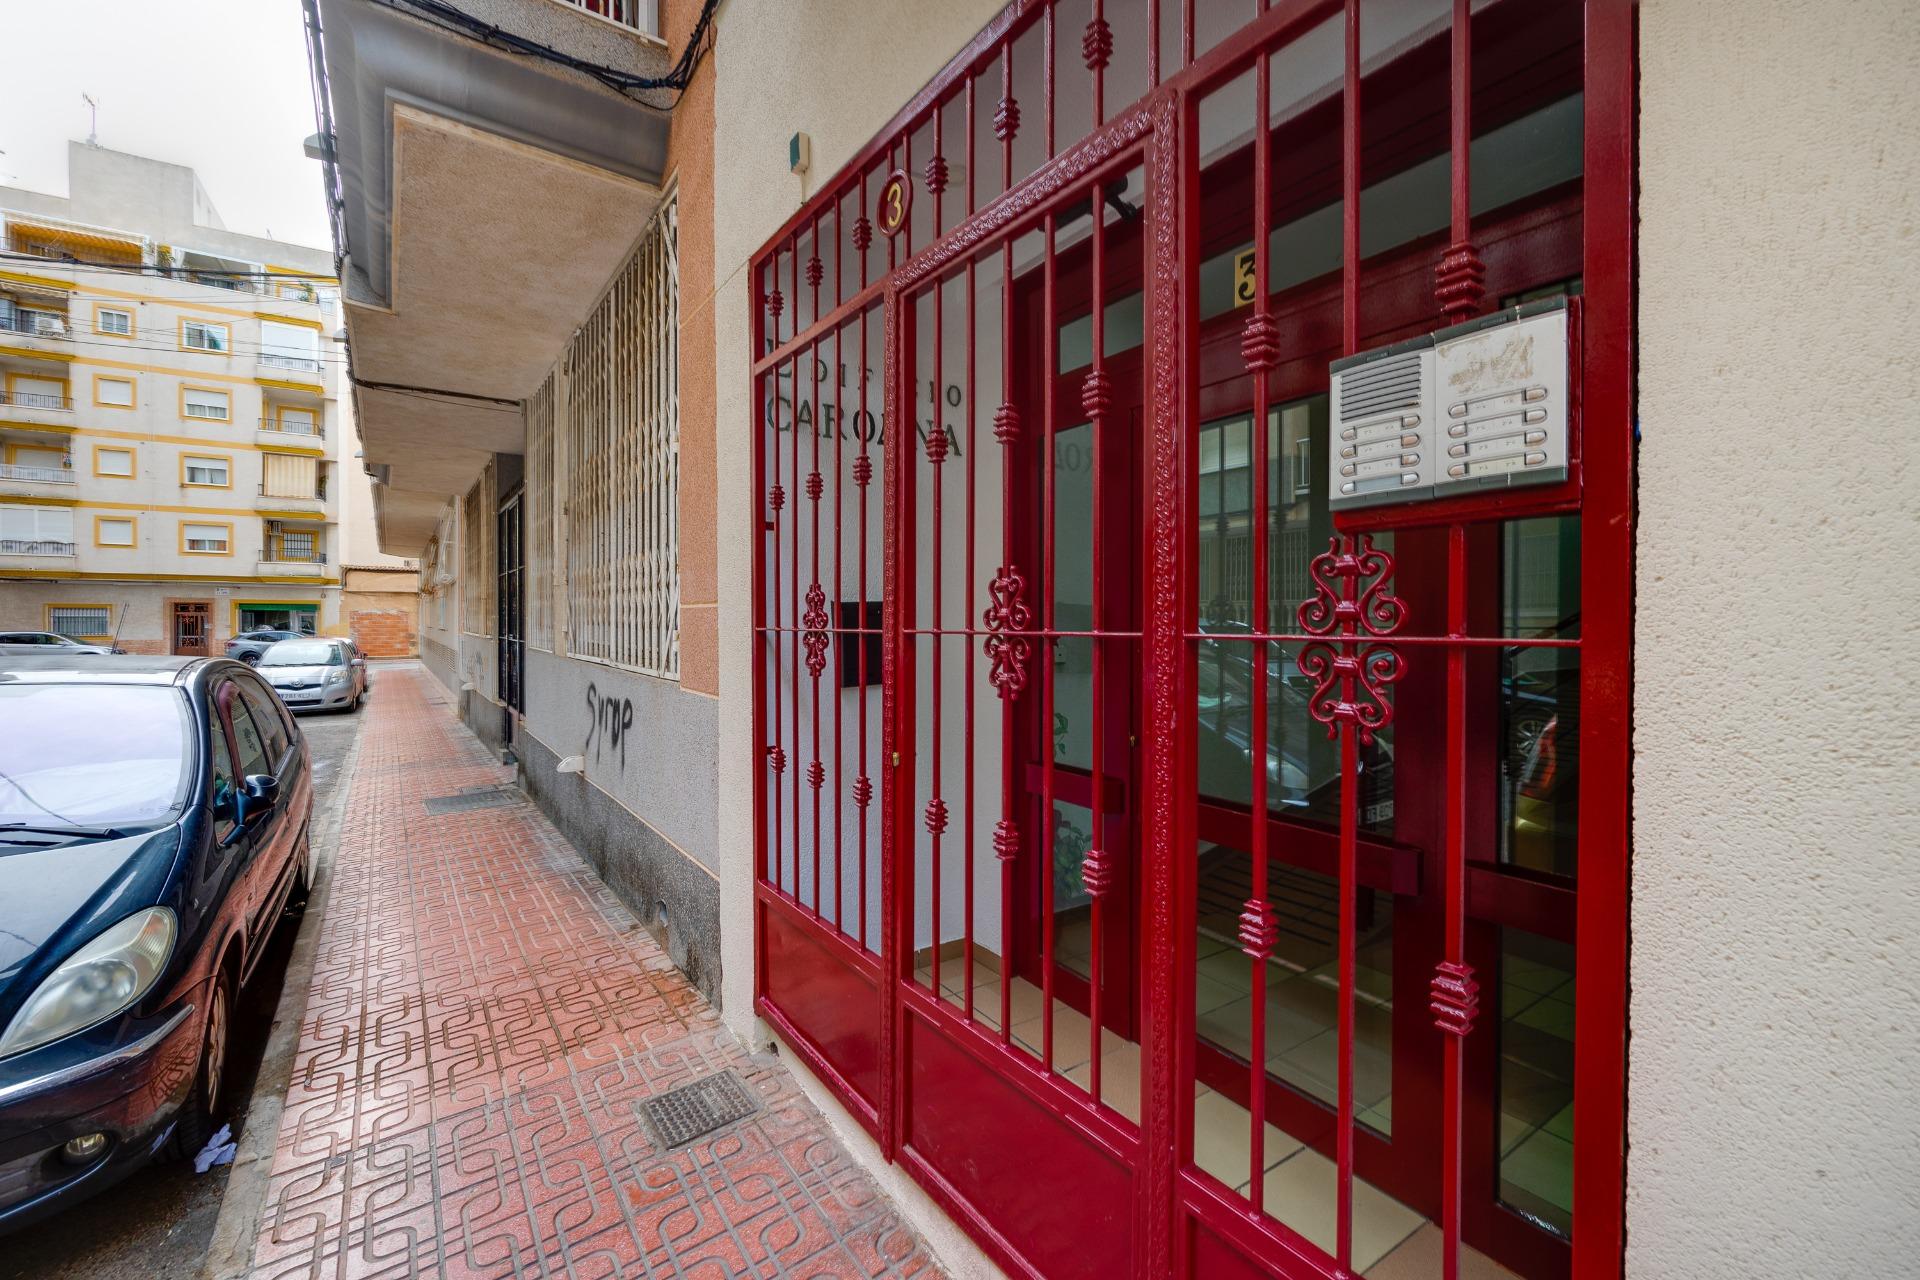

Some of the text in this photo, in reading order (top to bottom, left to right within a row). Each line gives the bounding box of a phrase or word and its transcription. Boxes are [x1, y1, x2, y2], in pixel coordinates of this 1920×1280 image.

[888, 182, 903, 228] 3
[1238, 252, 1256, 300] 3
[766, 338, 962, 408] EDIFIO
[767, 396, 962, 457] CARONA
